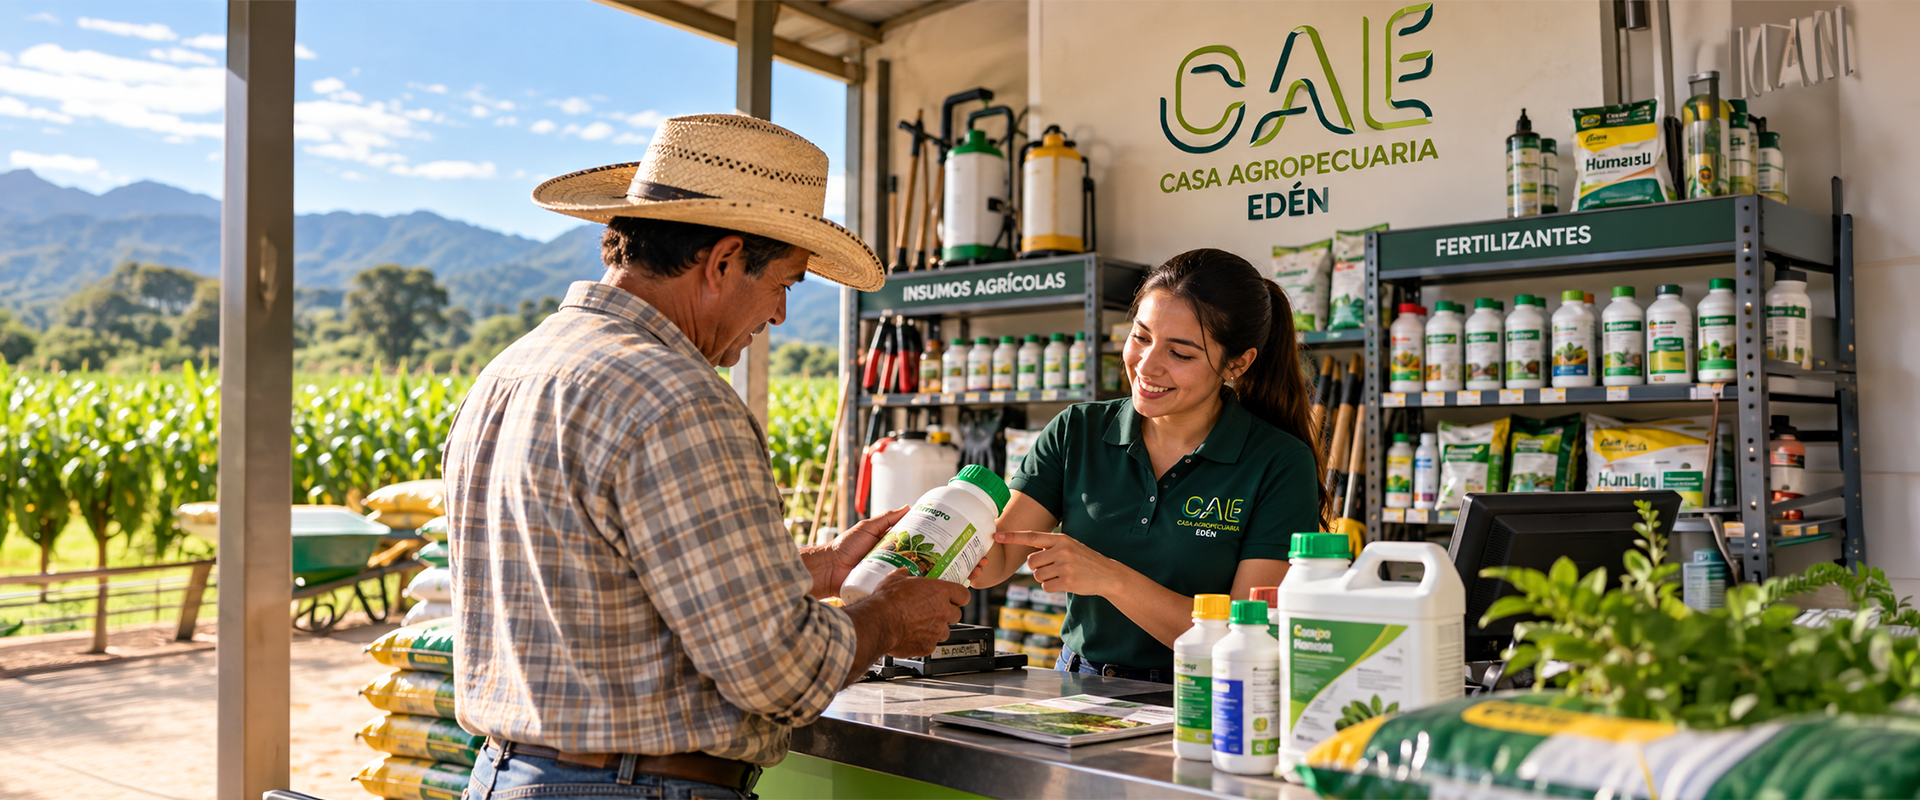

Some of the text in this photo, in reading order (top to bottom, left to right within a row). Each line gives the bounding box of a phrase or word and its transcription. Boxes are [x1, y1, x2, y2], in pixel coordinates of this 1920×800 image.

[1160, 138, 1439, 194] CASA AGROPECUARIA
[1248, 181, 1329, 221] EDÉN
[1435, 225, 1592, 257] FERTILIZANTES
[903, 271, 1067, 303] INSUMOS AGRÍCOLAS
